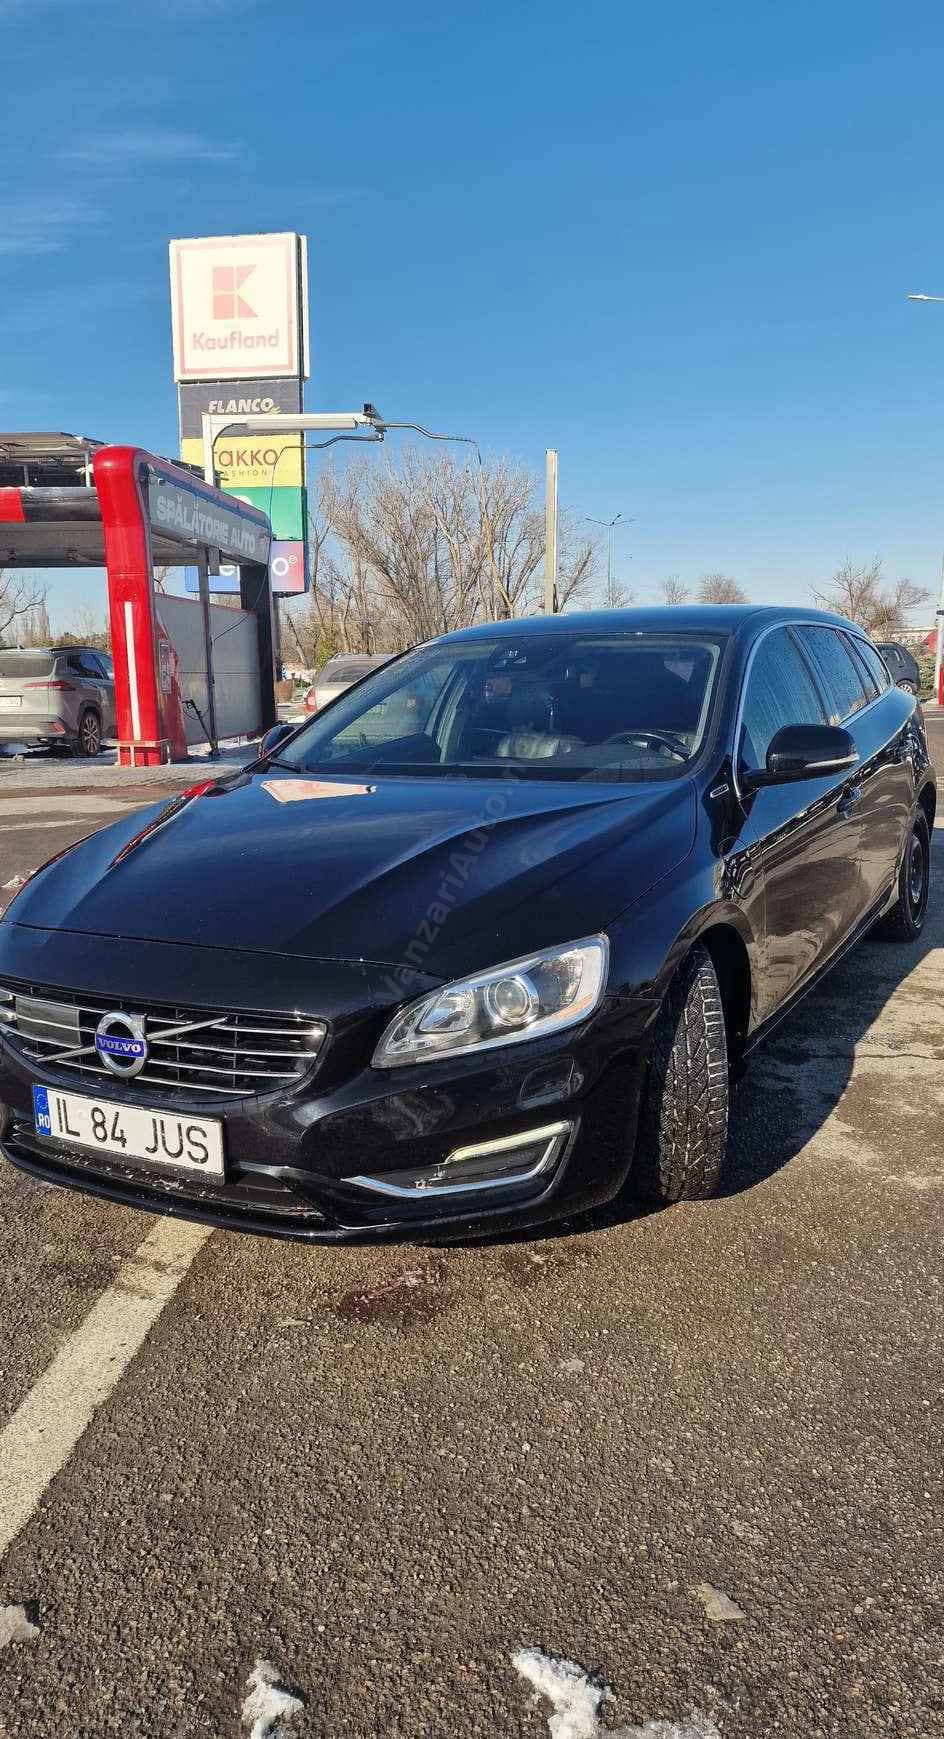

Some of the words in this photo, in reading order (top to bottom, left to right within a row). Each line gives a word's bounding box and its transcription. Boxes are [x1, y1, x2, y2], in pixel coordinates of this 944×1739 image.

[193, 328, 280, 351] Kaufland
[208, 398, 274, 414] FLANCO
[216, 449, 278, 467] akko
[222, 469, 268, 478] ASHION
[156, 495, 229, 544] SPĂLĂTORIE
[230, 527, 256, 554] AUTO
[97, 1038, 142, 1053] VOLVO
[38, 1112, 51, 1129] RO
[56, 1097, 80, 1137] IL
[91, 1107, 127, 1148] 84
[145, 1118, 209, 1164] JUS
